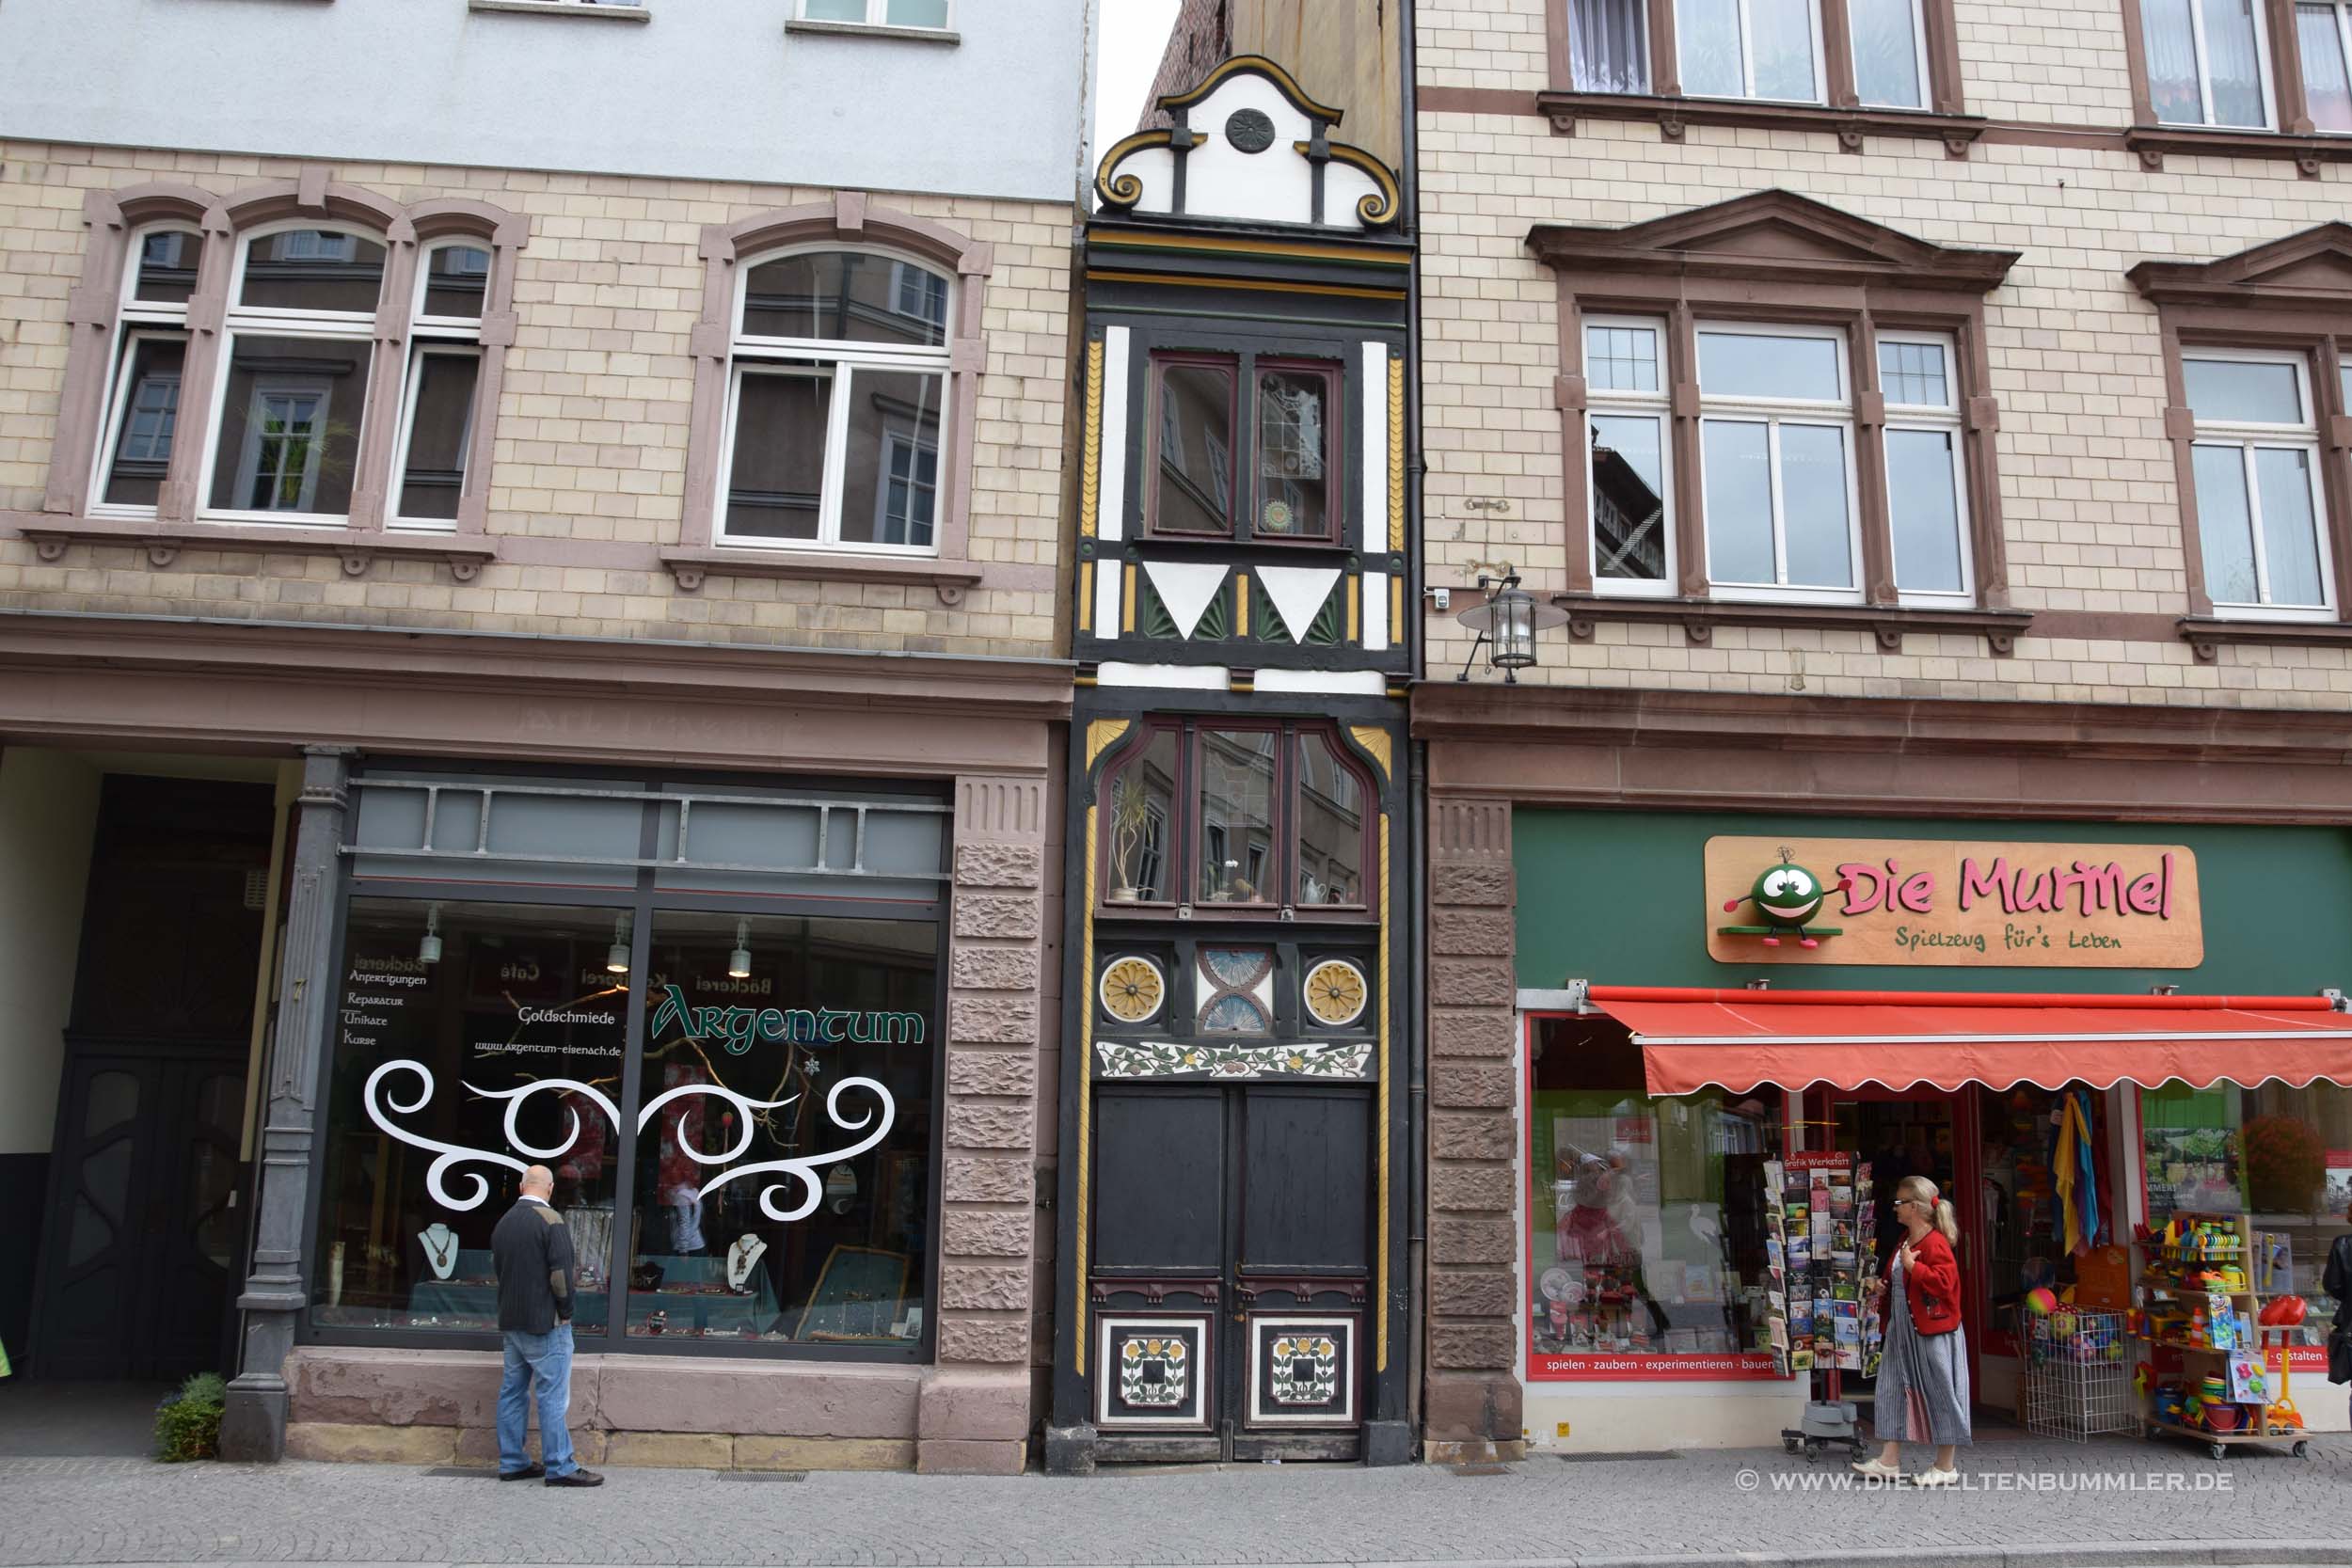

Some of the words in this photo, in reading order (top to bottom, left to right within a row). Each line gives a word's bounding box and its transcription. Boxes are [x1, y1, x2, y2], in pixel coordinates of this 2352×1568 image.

[1836, 858, 1933, 917] Die
[1958, 852, 2175, 921] Murmel
[1895, 926, 1986, 953] Spielzeug
[2069, 930, 2122, 950] Leben
[349, 970, 427, 987] Anfertigungen
[293, 978, 308, 1002] 7
[347, 992, 404, 1006] Reparatur
[343, 1010, 388, 1026] Unikate
[518, 1006, 615, 1025] Goldschmiede
[652, 984, 925, 1056] Argentum
[342, 1029, 377, 1045] Kurse
[474, 1041, 622, 1057] www.argentum-eisenach.de
[1808, 1157, 1850, 1166] Werkstatt
[2276, 1350, 2323, 1363] gstalten
[1547, 1358, 1585, 1371] spielen
[1594, 1358, 1638, 1370] zaubern
[1645, 1358, 1734, 1372] experimentieren
[1741, 1358, 1775, 1370] bauen
